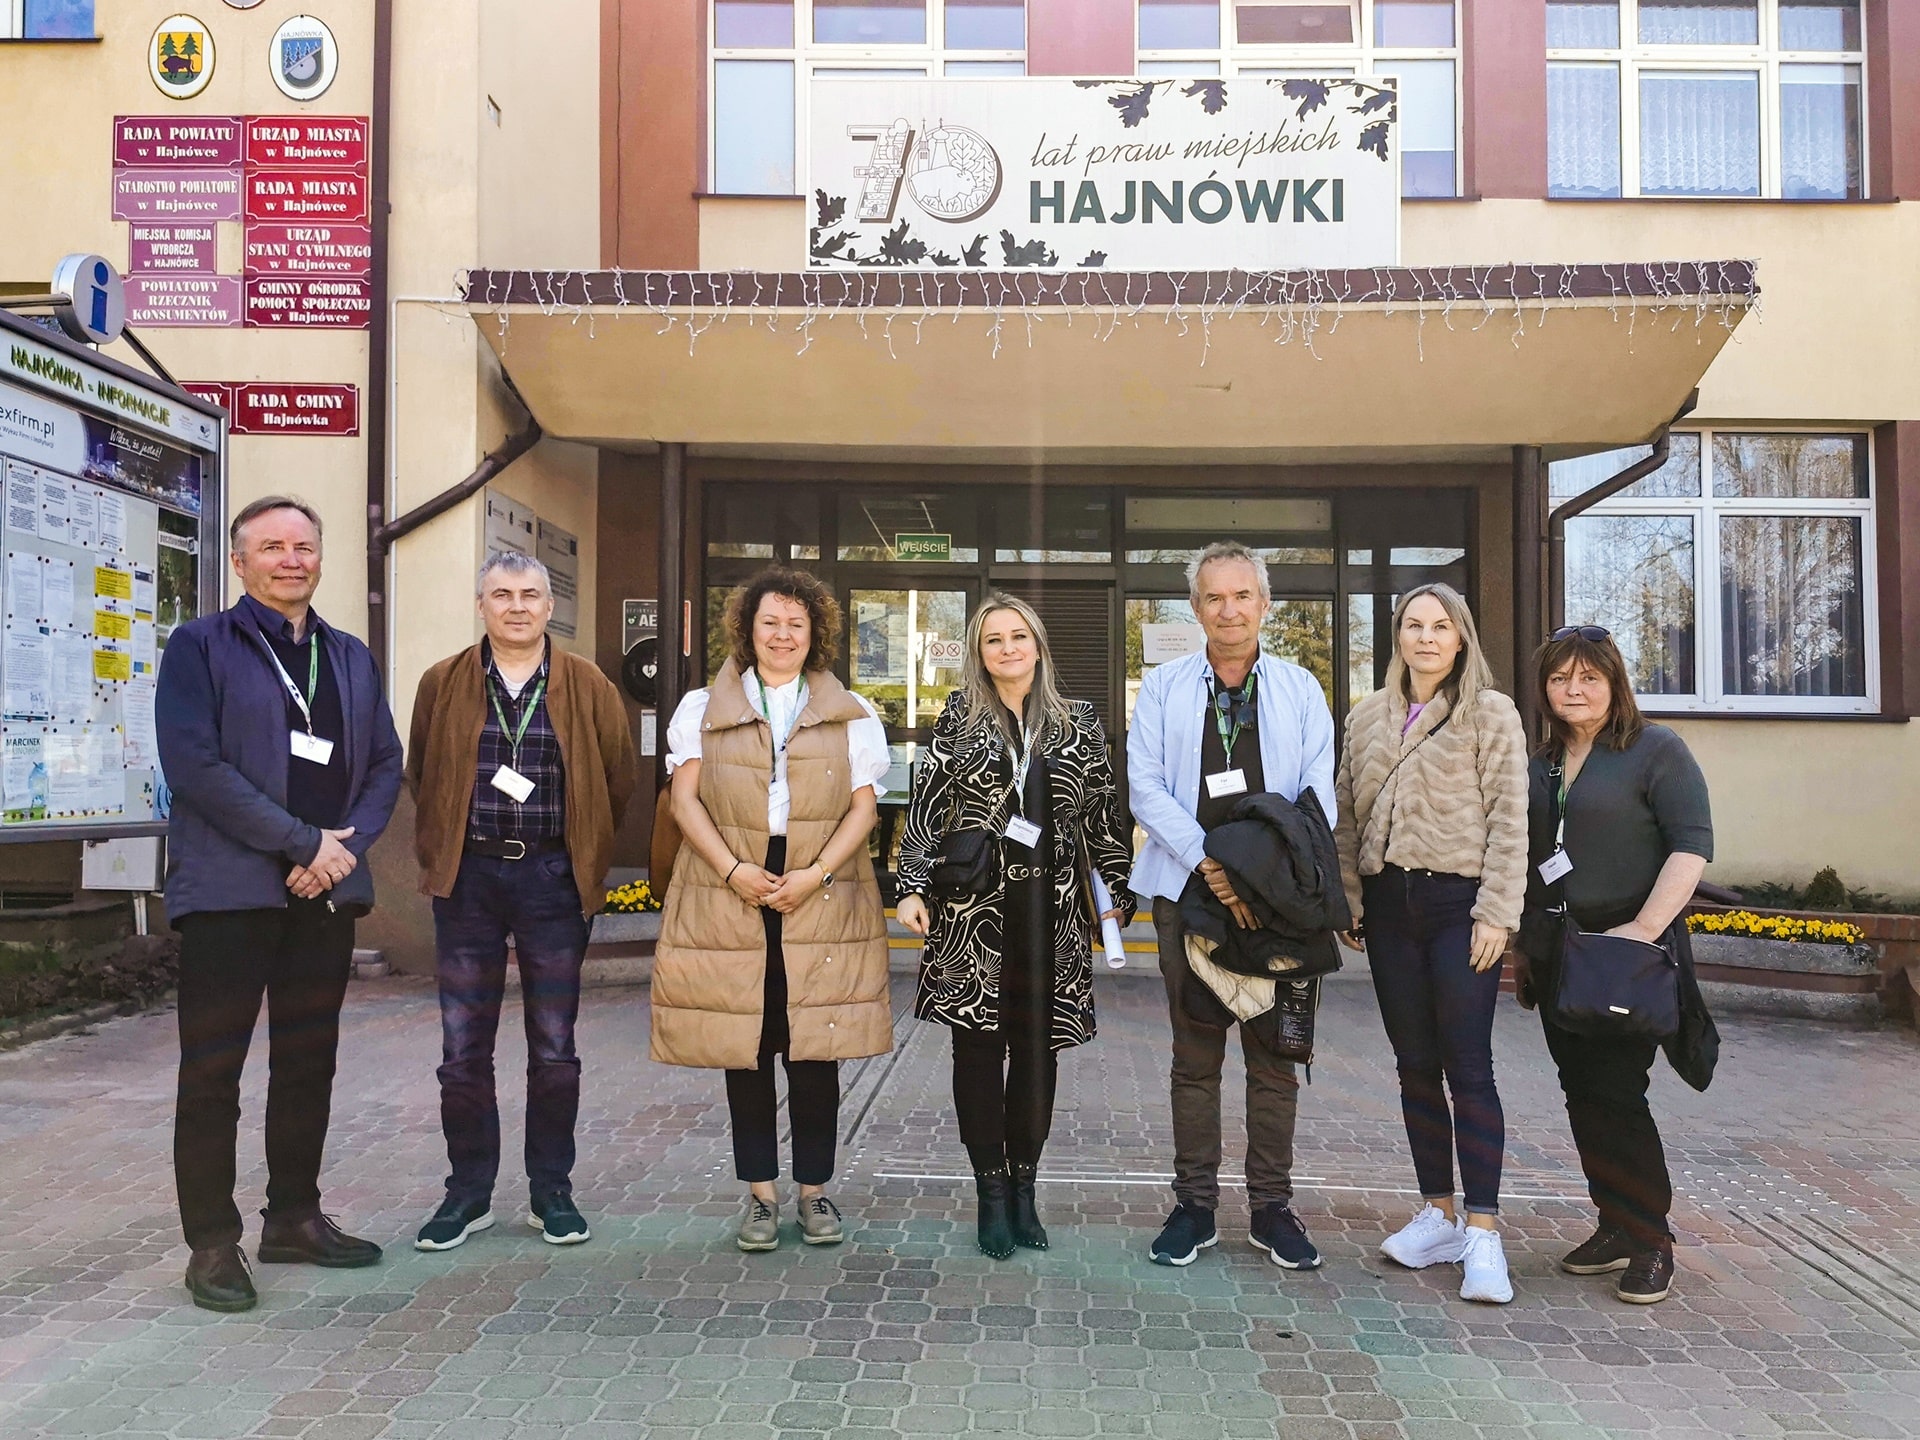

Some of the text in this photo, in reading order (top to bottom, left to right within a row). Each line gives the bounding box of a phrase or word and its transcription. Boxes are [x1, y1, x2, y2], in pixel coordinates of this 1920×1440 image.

[123, 127, 235, 142] RADA POWIATU
[252, 127, 361, 144] URZĄD MIASTA
[138, 146, 219, 158] w Hajnówce
[266, 146, 347, 159] w Hajnówce
[1031, 116, 1341, 176] lat praw miejskich
[847, 118, 1003, 224] 70
[118, 180, 237, 194] STAROSTWO POWIATOWE
[255, 181, 357, 195] RADA MIASTA
[1030, 171, 1345, 224] HAJNÓWKI
[138, 199, 218, 211] w Hajnówce
[265, 200, 347, 212] w Hajnówce
[134, 228, 212, 241] MIEJSKA KOMISJA
[287, 228, 331, 244] URZĄD
[151, 243, 194, 256] WYBORCZA
[248, 244, 371, 258] STANU CYWILNEGO
[154, 258, 199, 268] HAJNÓWCE
[269, 259, 351, 271] w Hajnówce
[141, 280, 219, 292] POWIATOWY
[258, 280, 361, 296] GMINNY OŚRODEK
[149, 295, 212, 307] RZECZNIK
[250, 297, 371, 310] POMOCY SPOŁECZNEJ
[132, 308, 229, 321] KONSUMENTÓW
[271, 311, 350, 323] w Hajnówce
[11, 344, 84, 394] HAJNÓWKA
[97, 381, 171, 427] INFORMACJE
[248, 394, 344, 409] RADA GMINY
[0, 406, 55, 438] exfirm.pl
[263, 413, 328, 426] Hajnówka
[899, 540, 948, 553] WEJŚCIE
[639, 614, 657, 627] AE
[6, 737, 41, 747] MARCINEK
